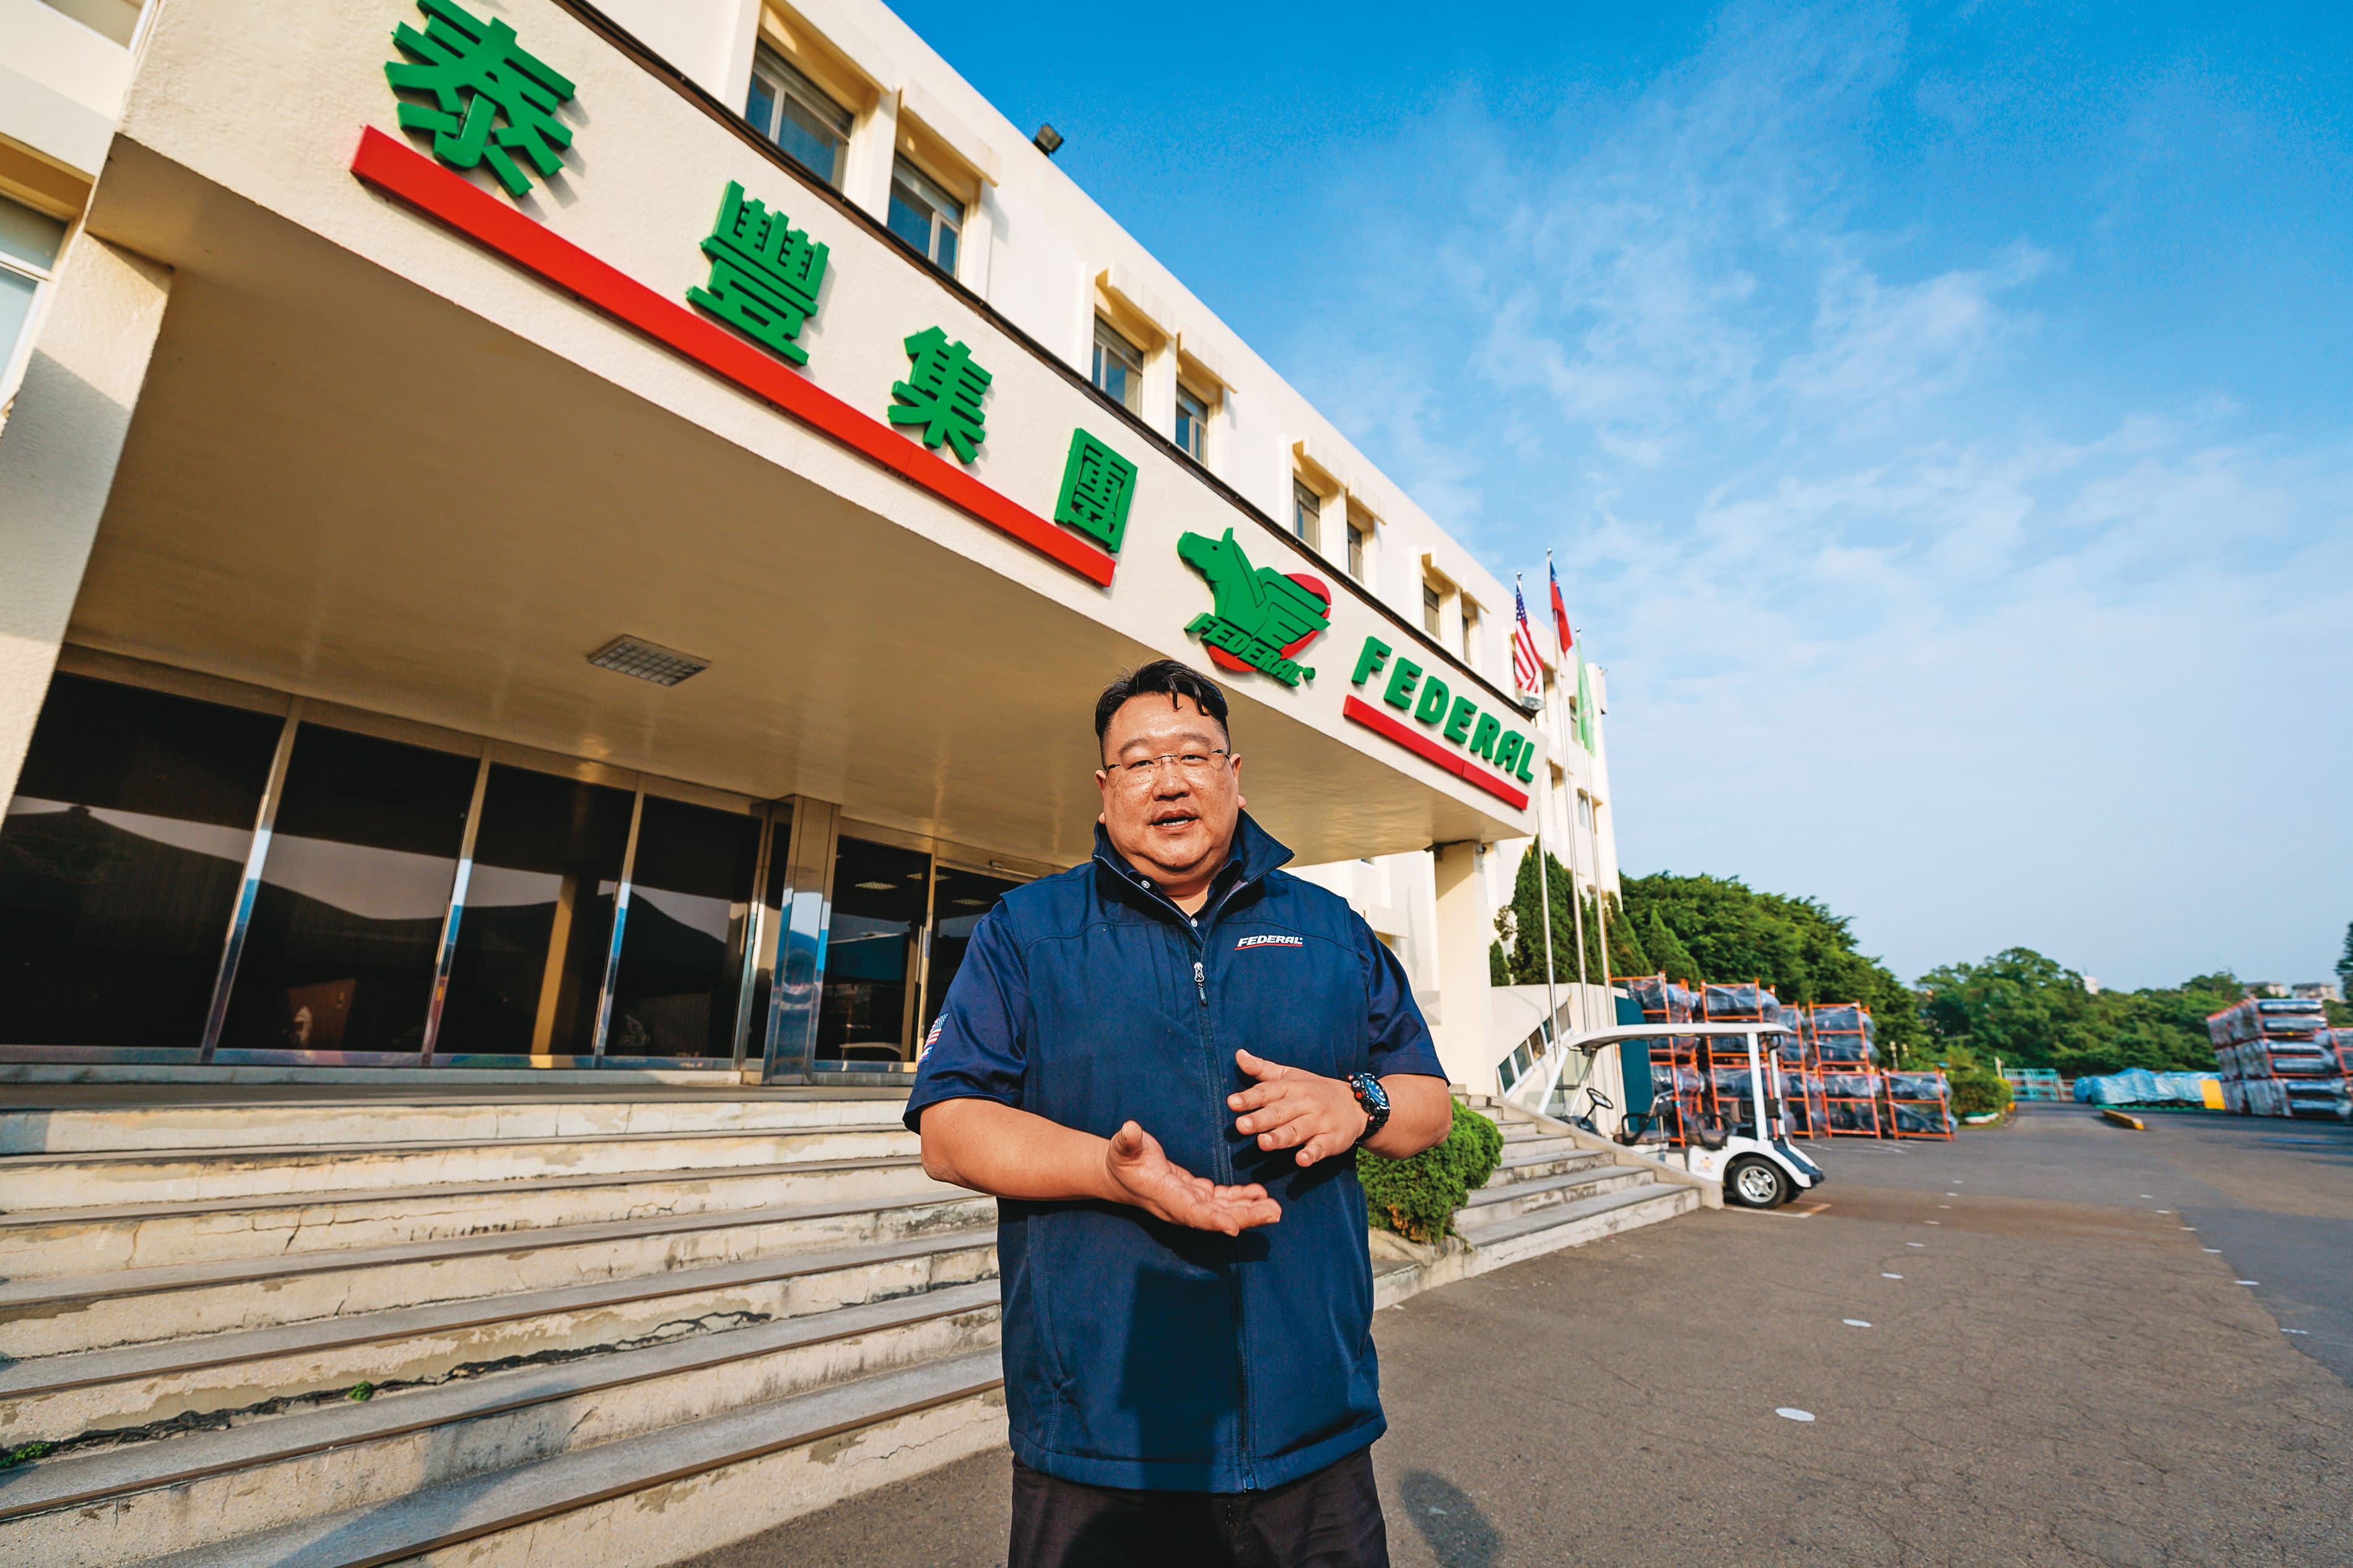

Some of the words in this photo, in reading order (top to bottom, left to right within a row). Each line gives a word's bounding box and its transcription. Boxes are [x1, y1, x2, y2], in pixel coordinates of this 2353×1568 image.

[384, 0, 1138, 553] 泰豐集團
[1183, 613, 1300, 687] FEDERAL
[1352, 636, 1535, 783] FEDERAL
[1237, 935, 1303, 947] FEDERAL
